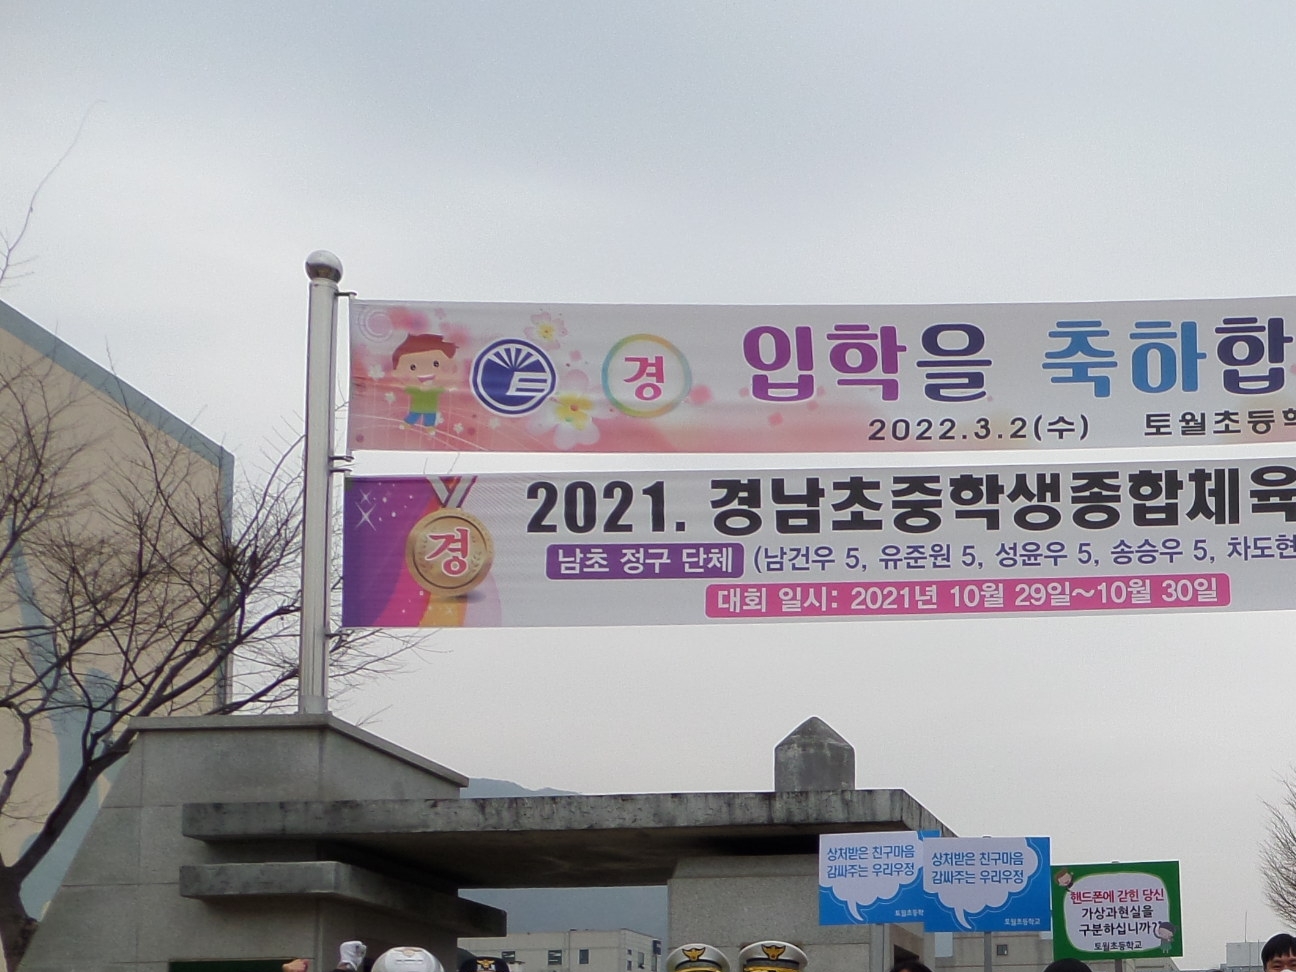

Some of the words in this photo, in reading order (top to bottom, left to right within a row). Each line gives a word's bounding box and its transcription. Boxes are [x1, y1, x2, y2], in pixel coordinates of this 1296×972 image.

[742, 322, 993, 403] 입학을
[622, 354, 666, 401] 경
[868, 414, 1091, 442] 2022.3.2(수)
[526, 480, 688, 534] 2021.
[424, 526, 471, 577] 경
[557, 548, 610, 575] 남초
[620, 547, 672, 574] 정구
[681, 546, 734, 574] 단체
[753, 543, 838, 574] (남건우
[844, 546, 868, 574] 5,
[877, 544, 955, 572] 유준원
[961, 543, 984, 572] 5,
[994, 542, 1070, 570] 성윤우
[1076, 542, 1100, 570] 5,
[1109, 536, 1186, 567] 송승우
[1192, 537, 1216, 566] 5,
[717, 586, 770, 614] 대회
[778, 585, 839, 614] 일시:
[850, 583, 939, 612] 2021년
[948, 582, 1006, 610] 10월
[1015, 574, 1152, 607] 29일~10월
[1160, 575, 1219, 604] 30일
[827, 846, 868, 861] 상처받은
[872, 844, 915, 860] 친구마음
[931, 851, 976, 867] 상처받은
[979, 850, 1024, 866] 친구마음
[827, 864, 868, 879] 감싸주는
[872, 862, 915, 877] 우리우정
[931, 869, 976, 885] 감싸주는
[979, 868, 1025, 884] 우리우정
[1070, 890, 1115, 905] 핸드폰에
[1117, 888, 1140, 904] 갇힌
[1142, 887, 1165, 903] 당신
[894, 908, 925, 917] 토월초등학
[1081, 905, 1154, 921] 가상과현실을
[1093, 940, 1143, 951] 토월초등학교
